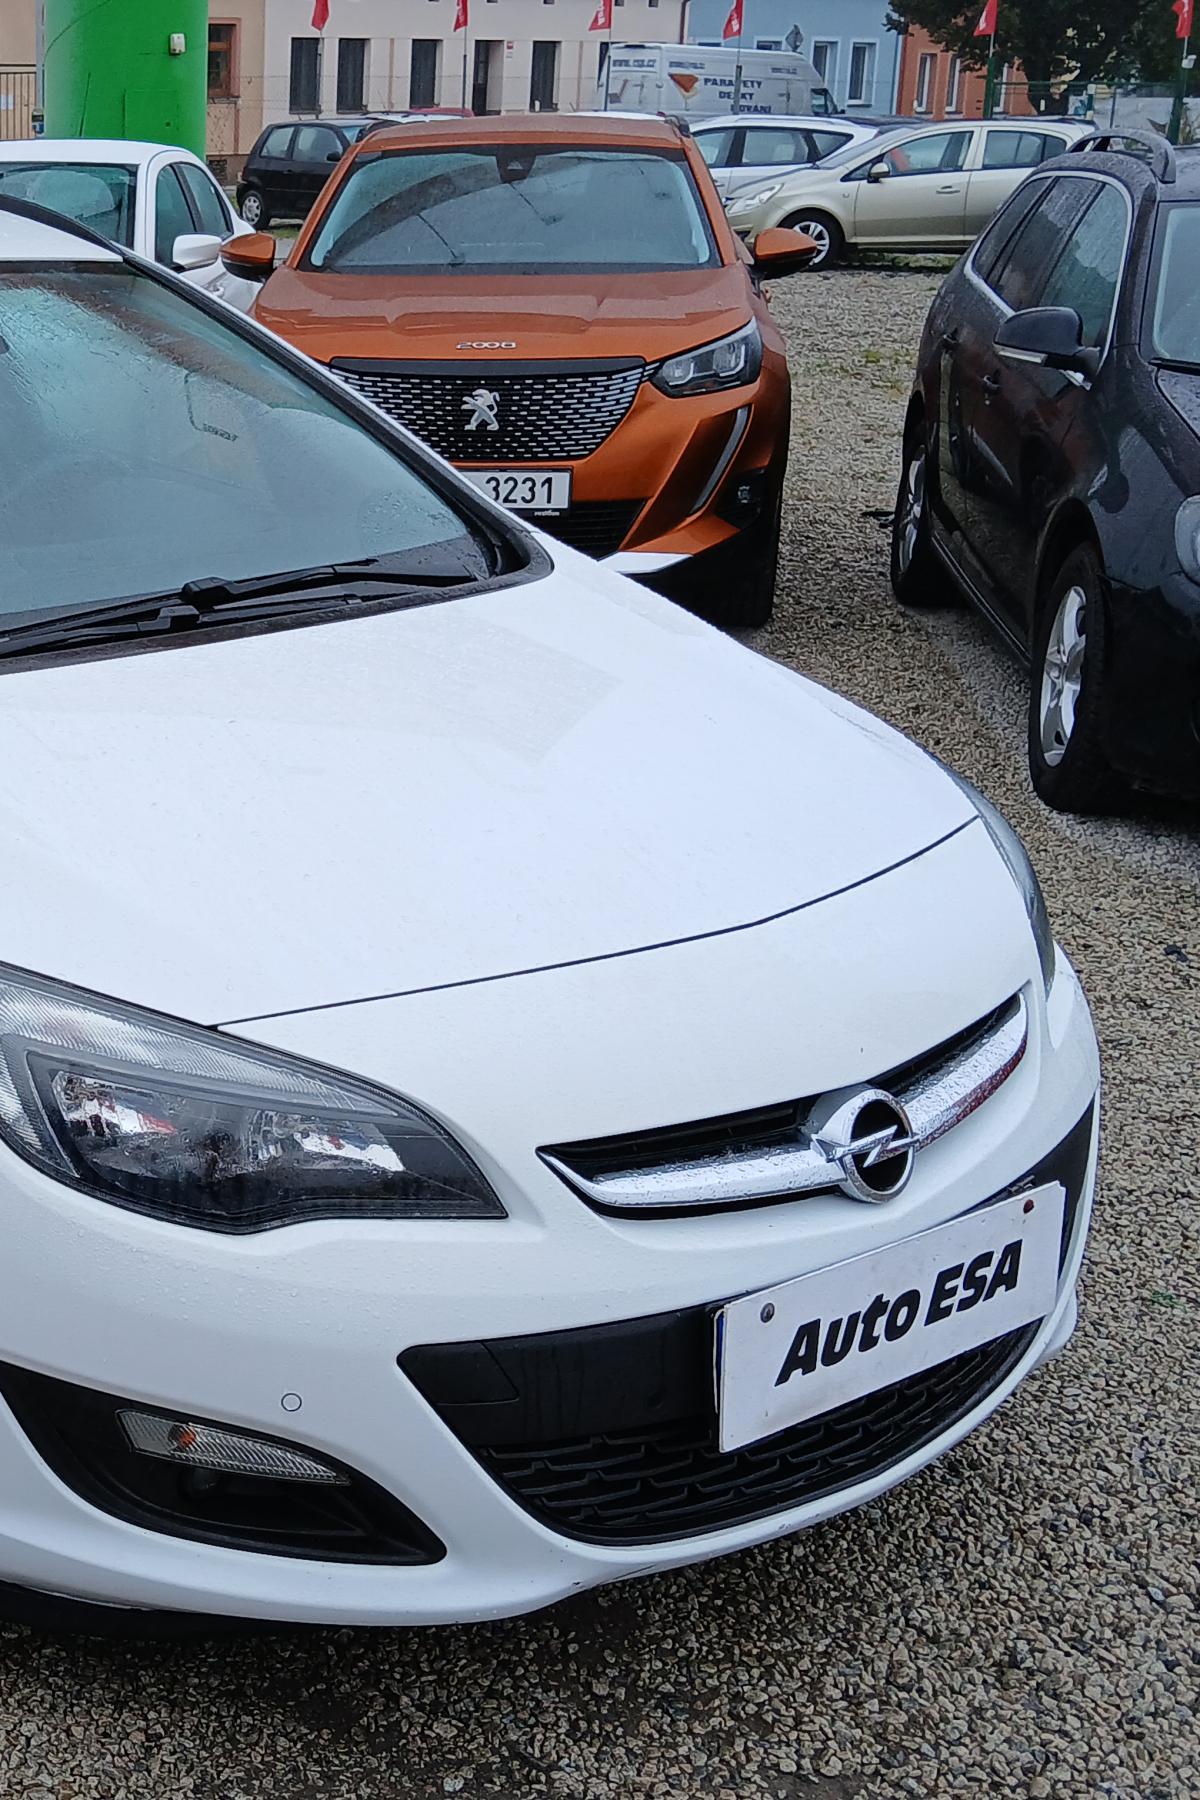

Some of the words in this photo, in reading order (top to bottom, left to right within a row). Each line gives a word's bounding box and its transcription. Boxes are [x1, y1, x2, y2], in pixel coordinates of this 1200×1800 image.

[703, 78, 762, 89] PARAETY
[718, 91, 754, 101] DEKY
[456, 341, 517, 349] 2008
[485, 476, 553, 504] 3231
